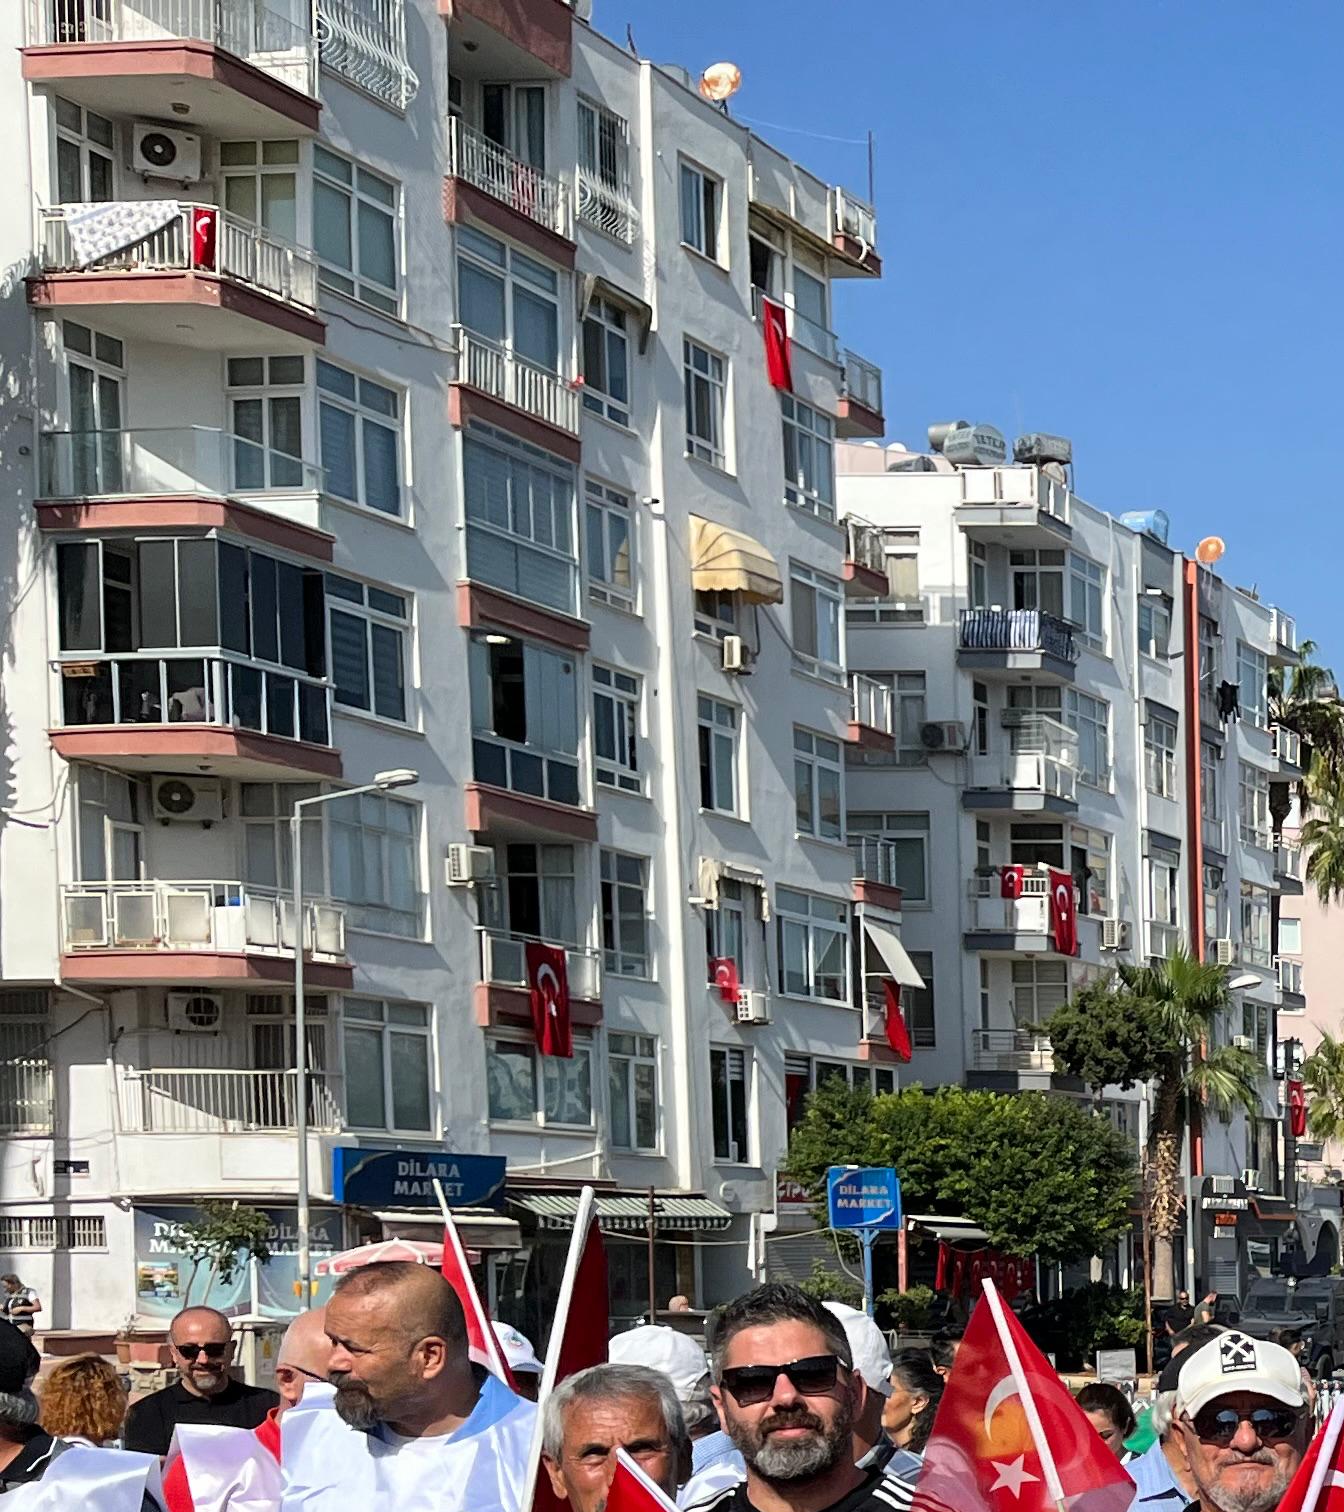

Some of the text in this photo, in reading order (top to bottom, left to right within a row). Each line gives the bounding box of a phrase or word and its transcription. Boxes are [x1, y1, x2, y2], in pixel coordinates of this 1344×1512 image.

[397, 1159, 461, 1179] DİLARA
[839, 1184, 888, 1195] DİLARA
[837, 1198, 892, 1209] MARKET
